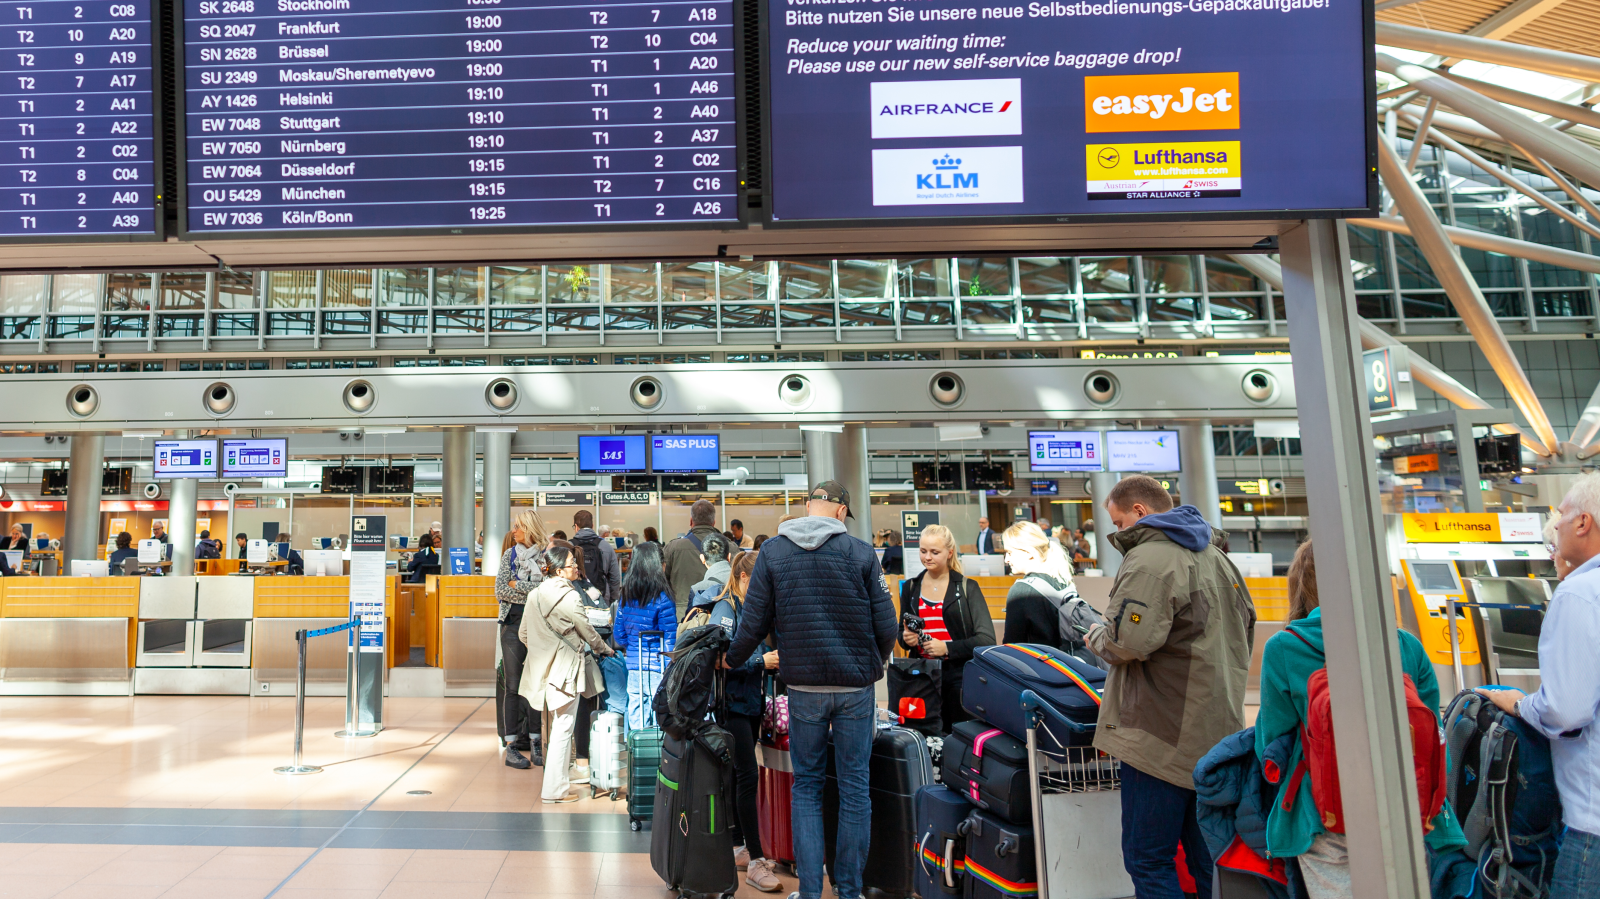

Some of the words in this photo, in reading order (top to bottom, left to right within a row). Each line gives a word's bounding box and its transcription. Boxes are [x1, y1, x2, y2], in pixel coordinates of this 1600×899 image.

[16, 7, 33, 20] T1
[74, 6, 83, 18] 2
[109, 4, 136, 17] C08
[199, 1, 219, 14] SK
[222, 0, 255, 14] 2648
[277, 0, 350, 12] Stockholm
[200, 24, 222, 38] SQ
[224, 23, 257, 38] 2047
[278, 20, 340, 35] Frankfurt
[465, 15, 502, 29] 19:00
[589, 11, 608, 25] T2
[651, 9, 660, 23] 7
[688, 7, 717, 22] A18
[786, 10, 823, 26] Bitte
[828, 10, 883, 24] nutzen
[888, 6, 915, 22] Sie
[920, 8, 977, 21] unsere
[982, 6, 1024, 19] neue
[16, 30, 34, 43] T2
[67, 29, 84, 42] 10
[109, 27, 136, 41] A20
[200, 48, 222, 61] SN
[224, 47, 257, 61] 2628
[279, 44, 329, 59] Brüssel
[466, 39, 503, 53] 19:00
[590, 35, 609, 49] T2
[644, 33, 662, 47] 10
[689, 32, 718, 46] C04
[787, 38, 848, 54] Reduce
[853, 40, 892, 55] your
[896, 34, 958, 52] waiting
[963, 34, 1006, 49] time:
[17, 53, 35, 66] T2
[74, 52, 84, 65] 9
[109, 51, 137, 64] A19
[788, 58, 841, 74] Please
[845, 59, 875, 72] use
[880, 58, 909, 72] our
[913, 57, 950, 70] new
[953, 52, 1050, 70] self-service
[1054, 50, 1129, 69] baggage
[1133, 48, 1182, 64] drop!
[200, 71, 222, 85] SU
[225, 70, 258, 84] 2349
[279, 66, 435, 82] Moskau/Sheremetyevo
[466, 62, 503, 77] 19:00
[590, 59, 607, 73] T1
[653, 58, 660, 71] 1
[689, 56, 718, 70] A20
[17, 76, 35, 90] T2
[75, 75, 84, 88] 7
[109, 74, 137, 87] A17
[201, 95, 222, 108] AY
[225, 94, 258, 107] 1426
[279, 91, 333, 106] Helsinki
[467, 86, 504, 101] 19:10
[591, 83, 608, 97] T1
[653, 82, 661, 95] 1
[689, 80, 719, 94] A46
[18, 100, 34, 113] T1
[76, 99, 85, 112] 2
[110, 98, 136, 111] A41
[1092, 87, 1232, 119] easyJet
[202, 118, 226, 132] EW
[228, 117, 261, 131] 7048
[279, 116, 341, 132] Stuttgart
[467, 110, 504, 125] 19:10
[591, 107, 609, 121] T1
[653, 106, 663, 119] 2
[690, 104, 719, 118] A40
[18, 123, 35, 136] T1
[76, 122, 85, 135] 2
[110, 121, 137, 134] A22
[202, 142, 227, 155] EW
[228, 141, 262, 155] 7050
[280, 139, 346, 155] Nürnberg
[468, 134, 505, 148] 19:10
[592, 131, 609, 145] T1
[654, 130, 663, 144] 2
[690, 129, 719, 143] A37
[19, 146, 35, 159] T1
[76, 145, 86, 158] 2
[112, 144, 138, 157] C02
[1134, 150, 1228, 164] Lufthansa
[203, 165, 227, 179] EW
[229, 165, 262, 178] 7064
[281, 162, 355, 177] Düsseldorf
[468, 158, 505, 172] 19:15
[592, 155, 610, 169] T1
[654, 154, 664, 168] 2
[692, 153, 720, 167] C02
[1134, 167, 1228, 176] www.lufthansa.com
[19, 169, 37, 183] T2
[76, 169, 86, 181] 8
[112, 168, 139, 181] C04
[916, 172, 979, 190] KLM
[203, 189, 226, 203] OU
[229, 188, 262, 202] 5429
[281, 186, 346, 200] München
[469, 182, 506, 196] 19:15
[593, 179, 612, 193] T2
[654, 178, 664, 192] 7
[693, 177, 721, 191] C16
[1104, 182, 1136, 190] Austrian
[19, 193, 36, 206] T1
[77, 192, 86, 205] 2
[112, 191, 139, 204] A40
[203, 212, 228, 226] EW
[230, 212, 263, 225] 7036
[282, 210, 353, 224] Köln/Bonn
[469, 206, 506, 220] 19:25
[593, 203, 611, 217] T1
[655, 203, 665, 216] 2
[692, 201, 721, 215] A26
[20, 216, 36, 229] T1
[78, 215, 87, 228] 2
[112, 215, 139, 227] A39
[1372, 360, 1386, 392] 8
[665, 439, 687, 449] SAS
[689, 439, 716, 449] PLUS
[602, 451, 623, 460] SAS
[1434, 522, 1492, 532] Lufthansa
